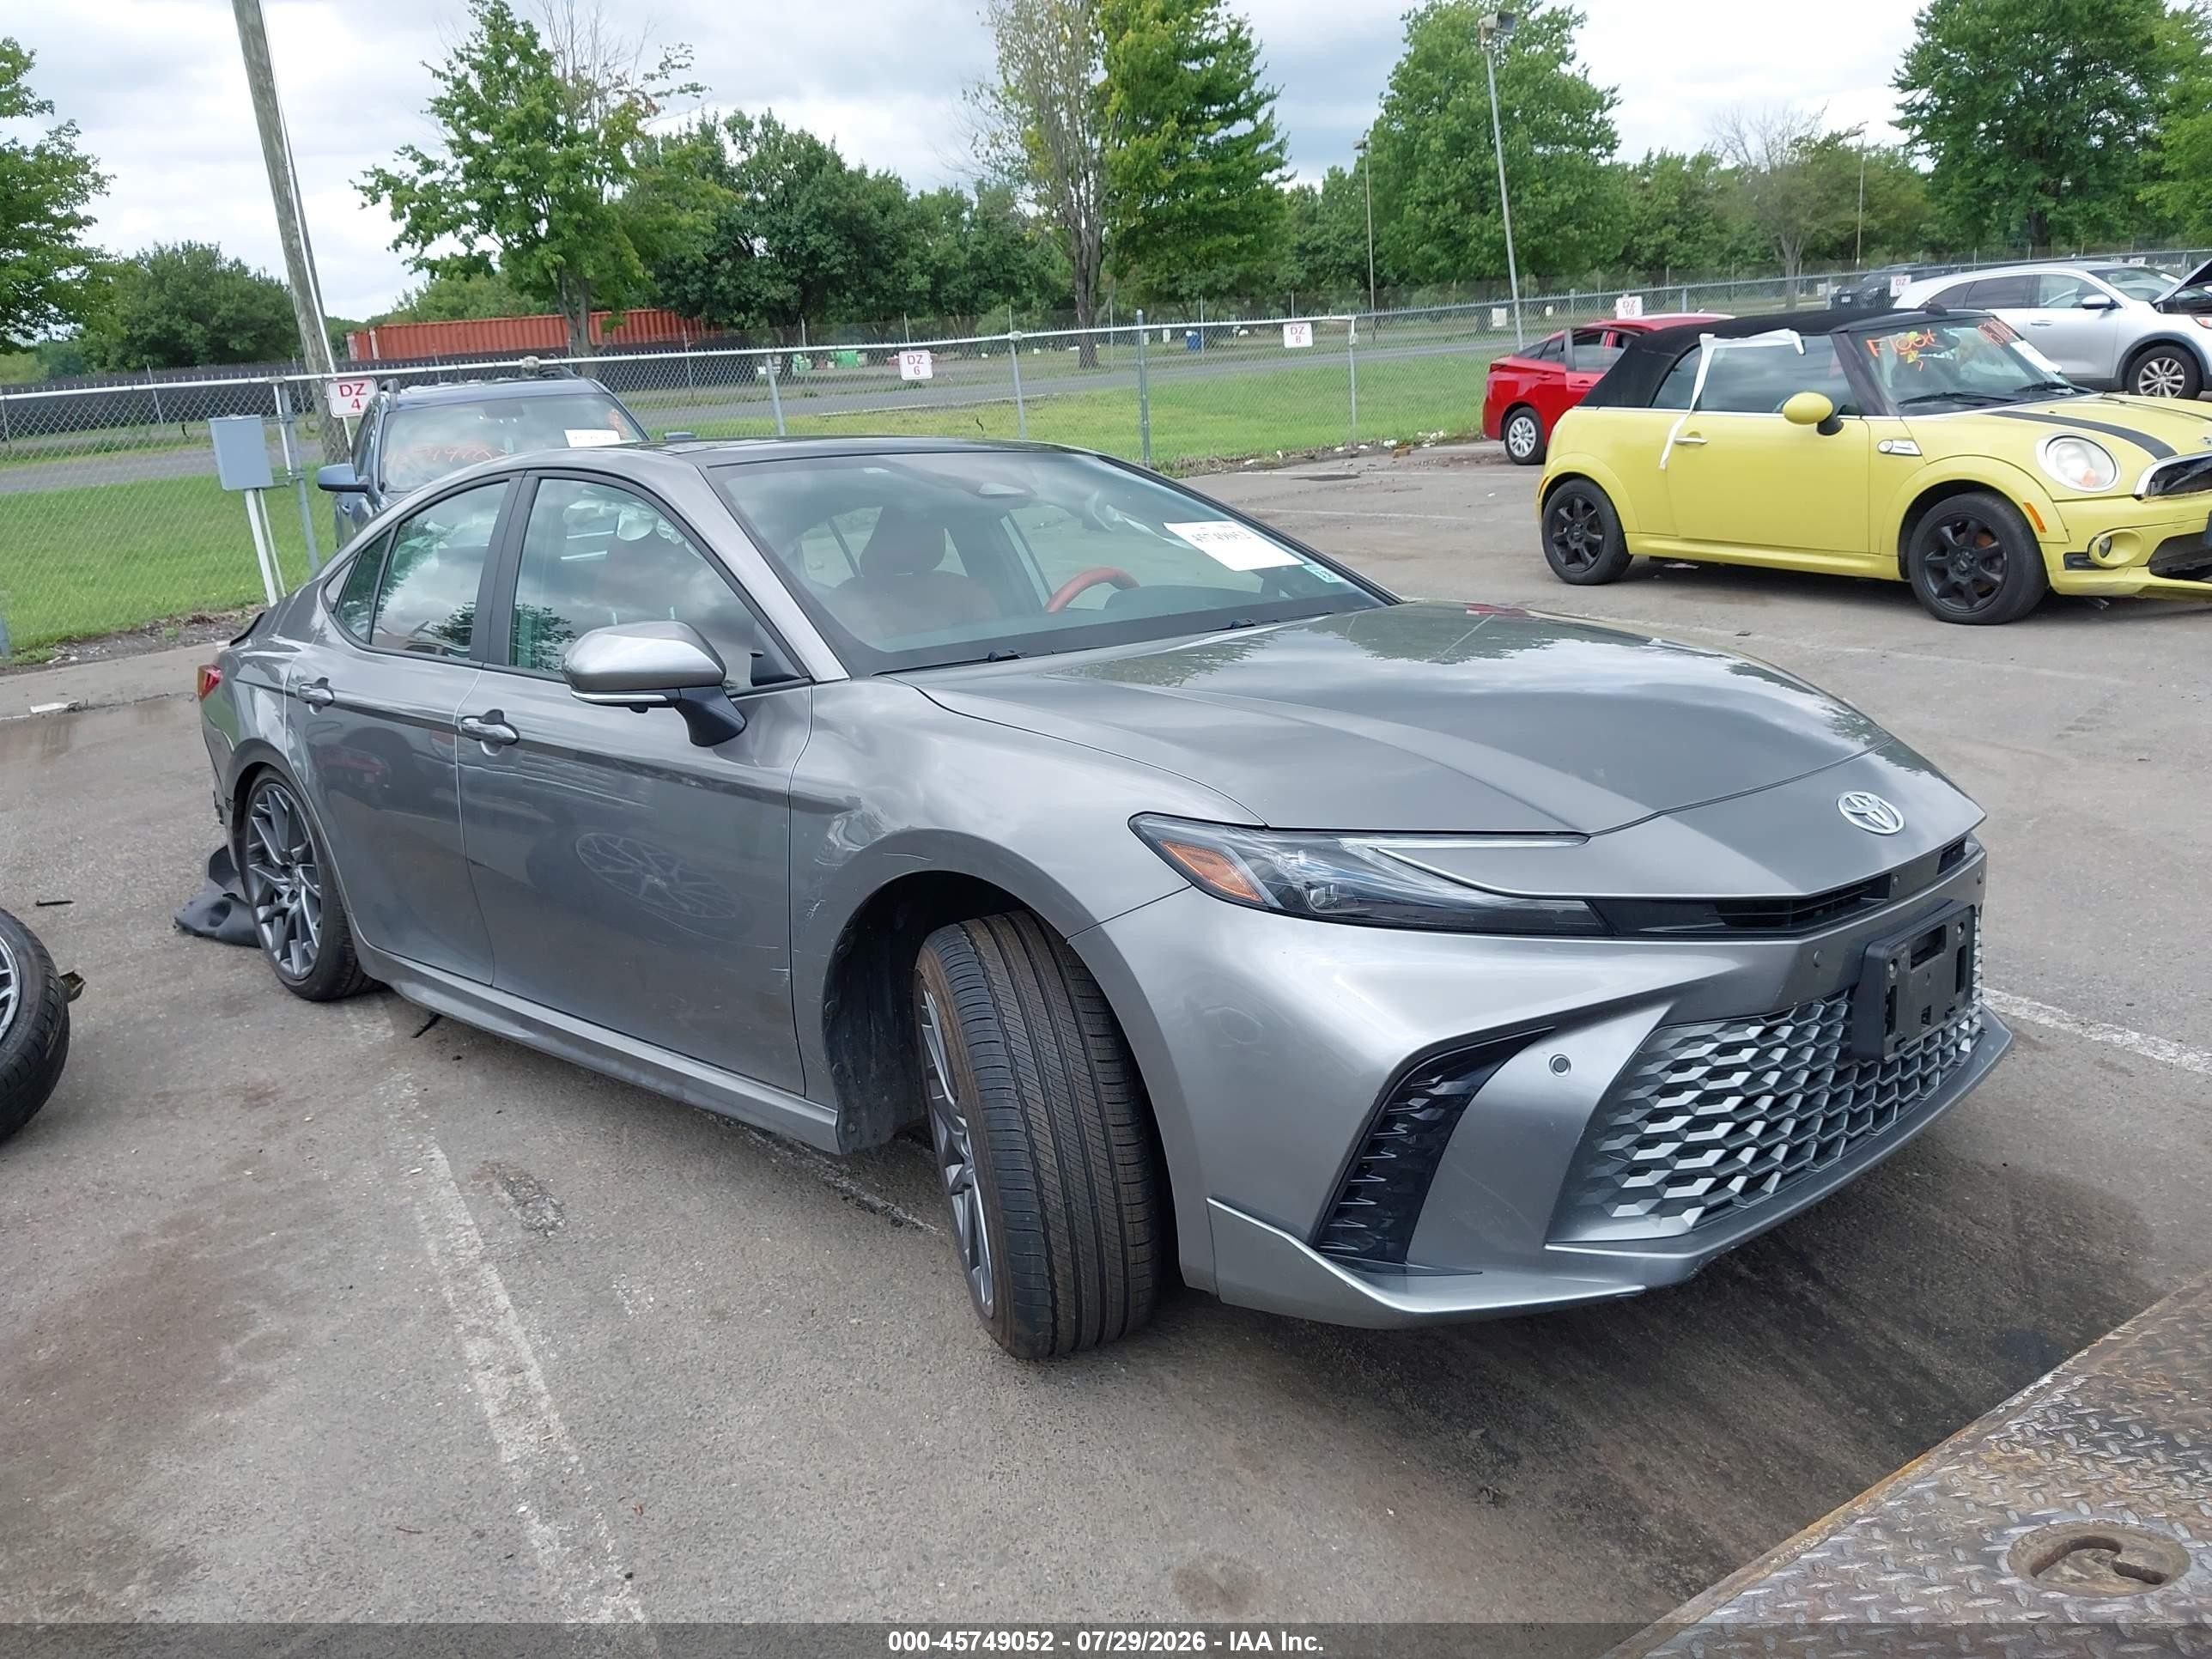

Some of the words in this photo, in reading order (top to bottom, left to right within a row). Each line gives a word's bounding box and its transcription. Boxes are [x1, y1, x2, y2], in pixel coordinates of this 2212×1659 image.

[1622, 299, 1636, 308] DZ
[1290, 325, 1305, 335] DZ
[907, 355, 924, 365] DZ
[913, 365, 921, 375] 6
[338, 383, 367, 398] DZ
[351, 398, 362, 410] 4
